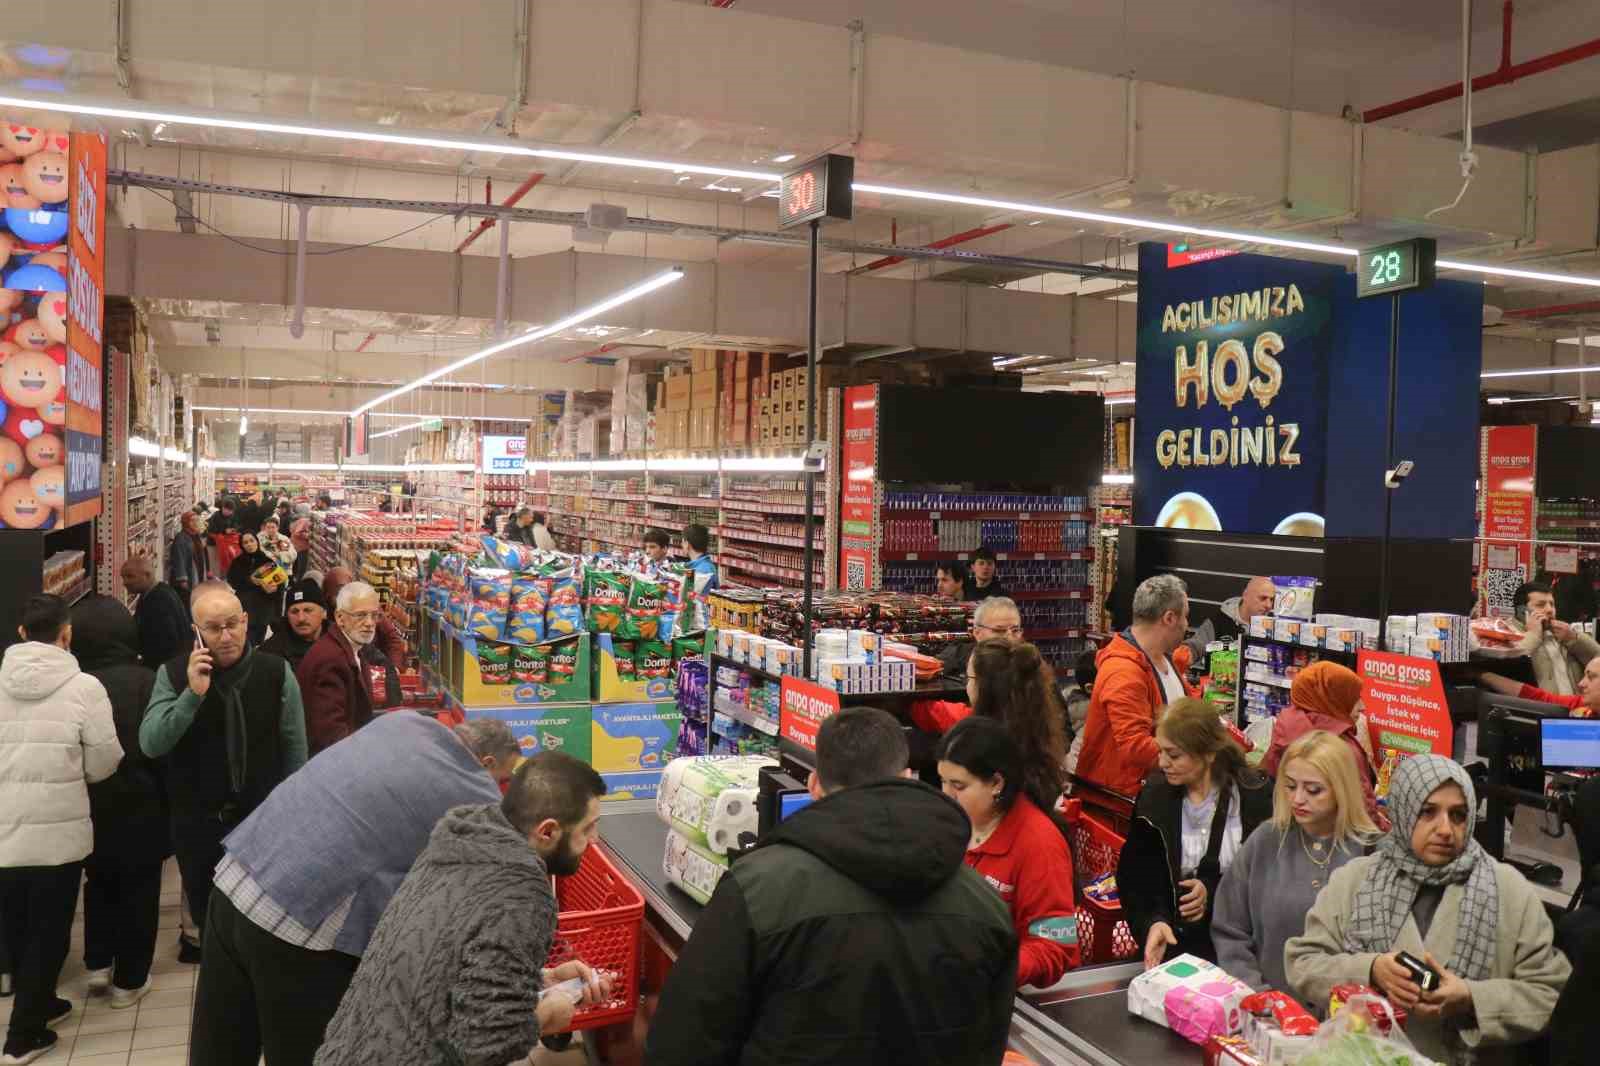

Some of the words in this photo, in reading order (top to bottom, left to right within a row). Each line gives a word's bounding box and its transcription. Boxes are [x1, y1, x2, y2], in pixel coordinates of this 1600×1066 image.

[788, 171, 817, 216] 30
[1370, 250, 1400, 286] 28
[1175, 331, 1285, 411] HOŞ
[1156, 415, 1301, 471] GELDİNİZ
[480, 662, 508, 673] oritos
[1364, 659, 1395, 678] anpa
[1398, 665, 1431, 682] gross
[785, 689, 808, 712] anpa
[1370, 688, 1399, 703] Duygu,
[1400, 694, 1440, 712] Düşünce,
[1369, 712, 1418, 733] Önerileriniz
[1387, 703, 1409, 717] İstek
[1410, 712, 1420, 721] ve
